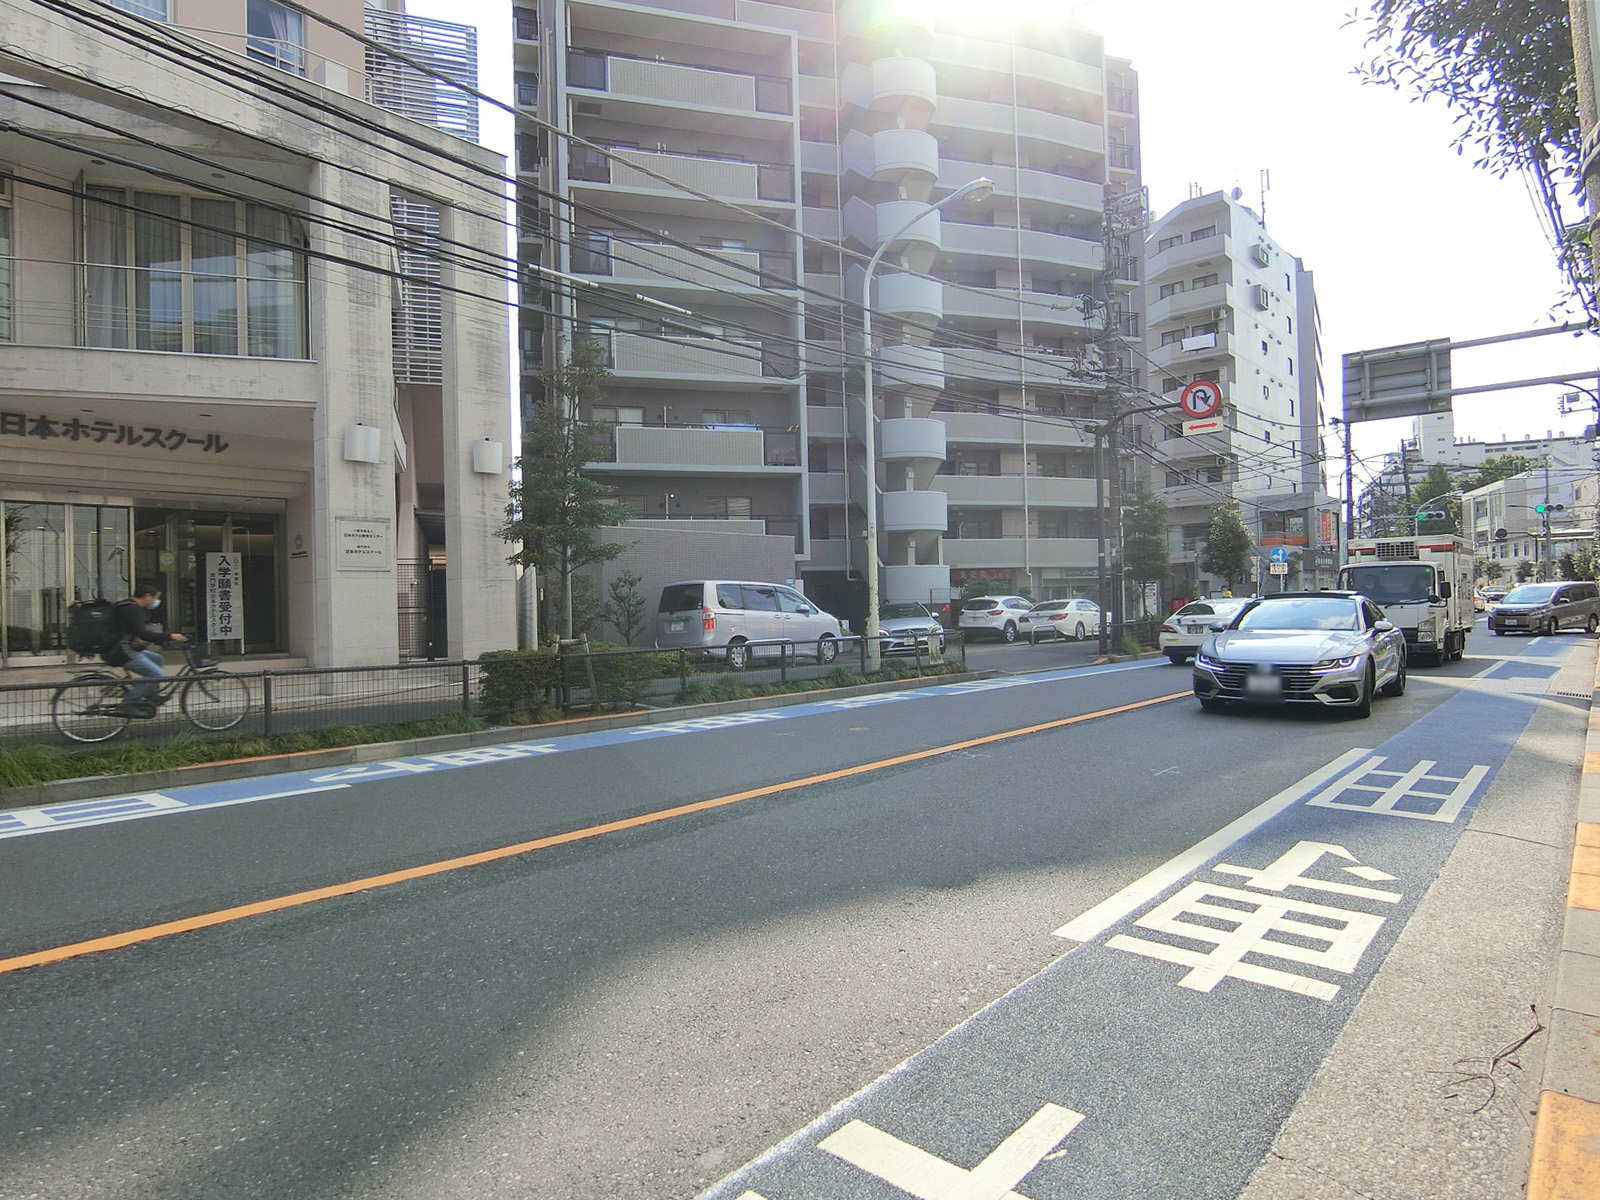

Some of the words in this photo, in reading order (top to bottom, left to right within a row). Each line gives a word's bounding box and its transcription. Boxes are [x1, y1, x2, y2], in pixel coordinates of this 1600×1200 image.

[0, 411, 229, 454] 日本ホテルスクール
[218, 555, 233, 637] 入学願書受付中
